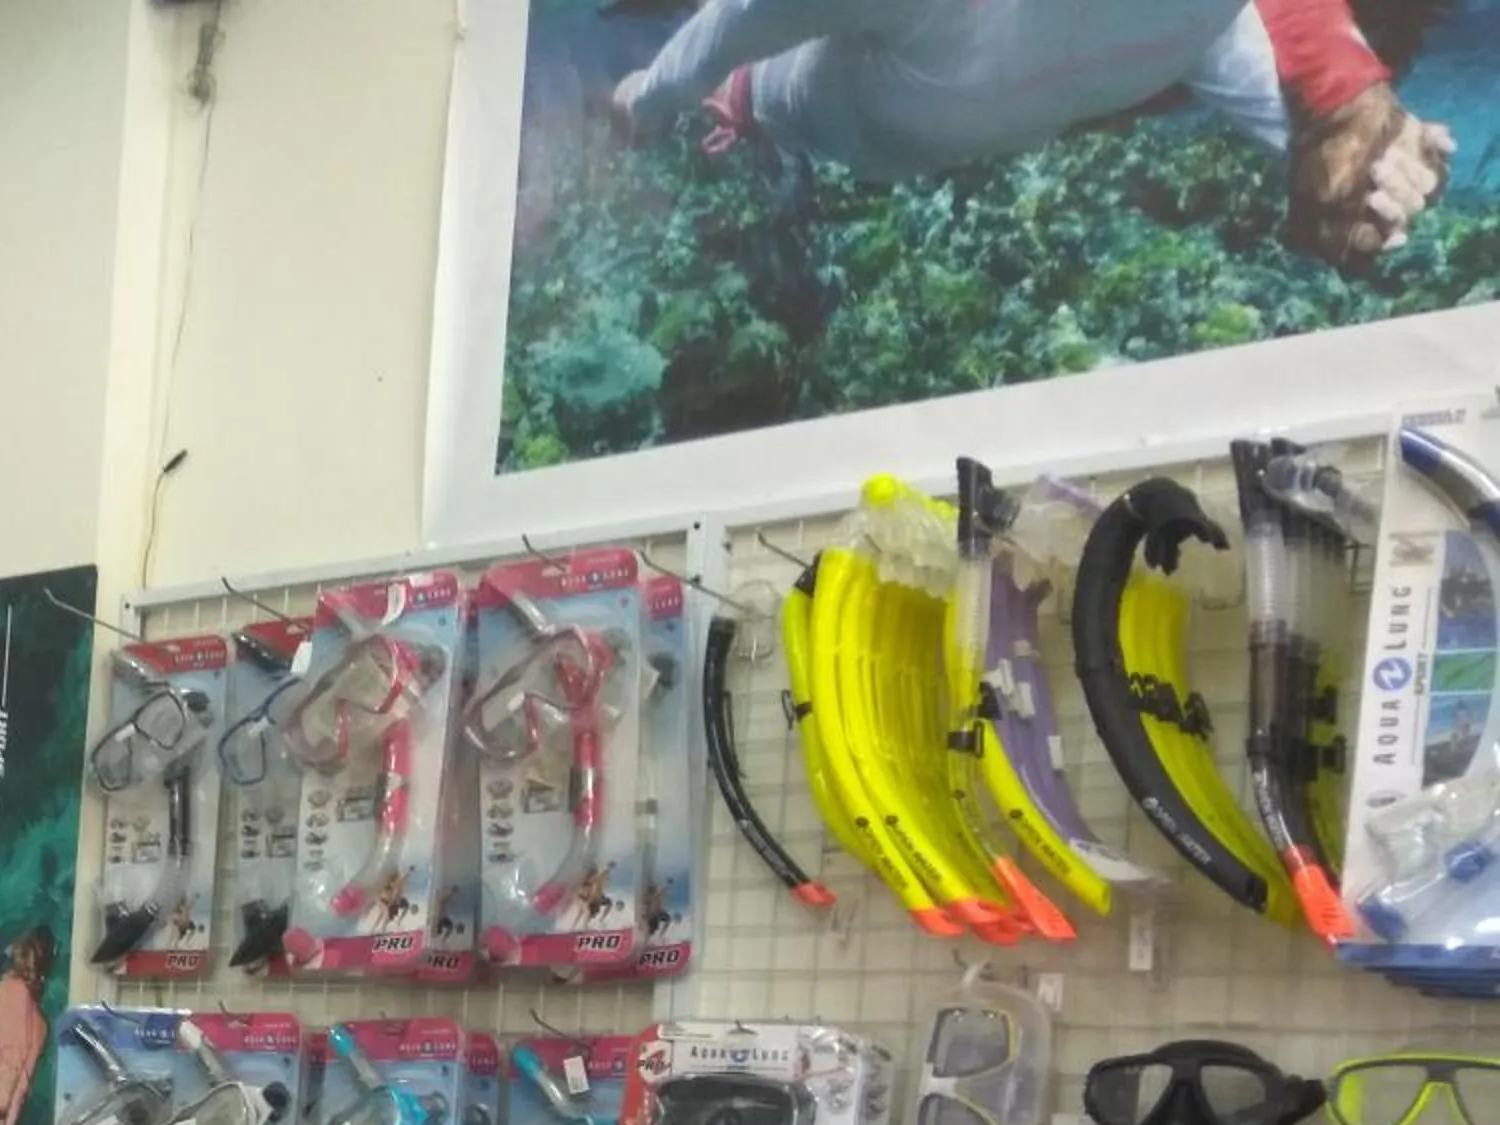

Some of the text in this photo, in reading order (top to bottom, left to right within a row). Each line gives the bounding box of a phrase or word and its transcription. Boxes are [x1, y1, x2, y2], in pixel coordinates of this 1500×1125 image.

[1372, 586, 1412, 766] AQUA LUNG
[578, 935, 621, 950] PRO
